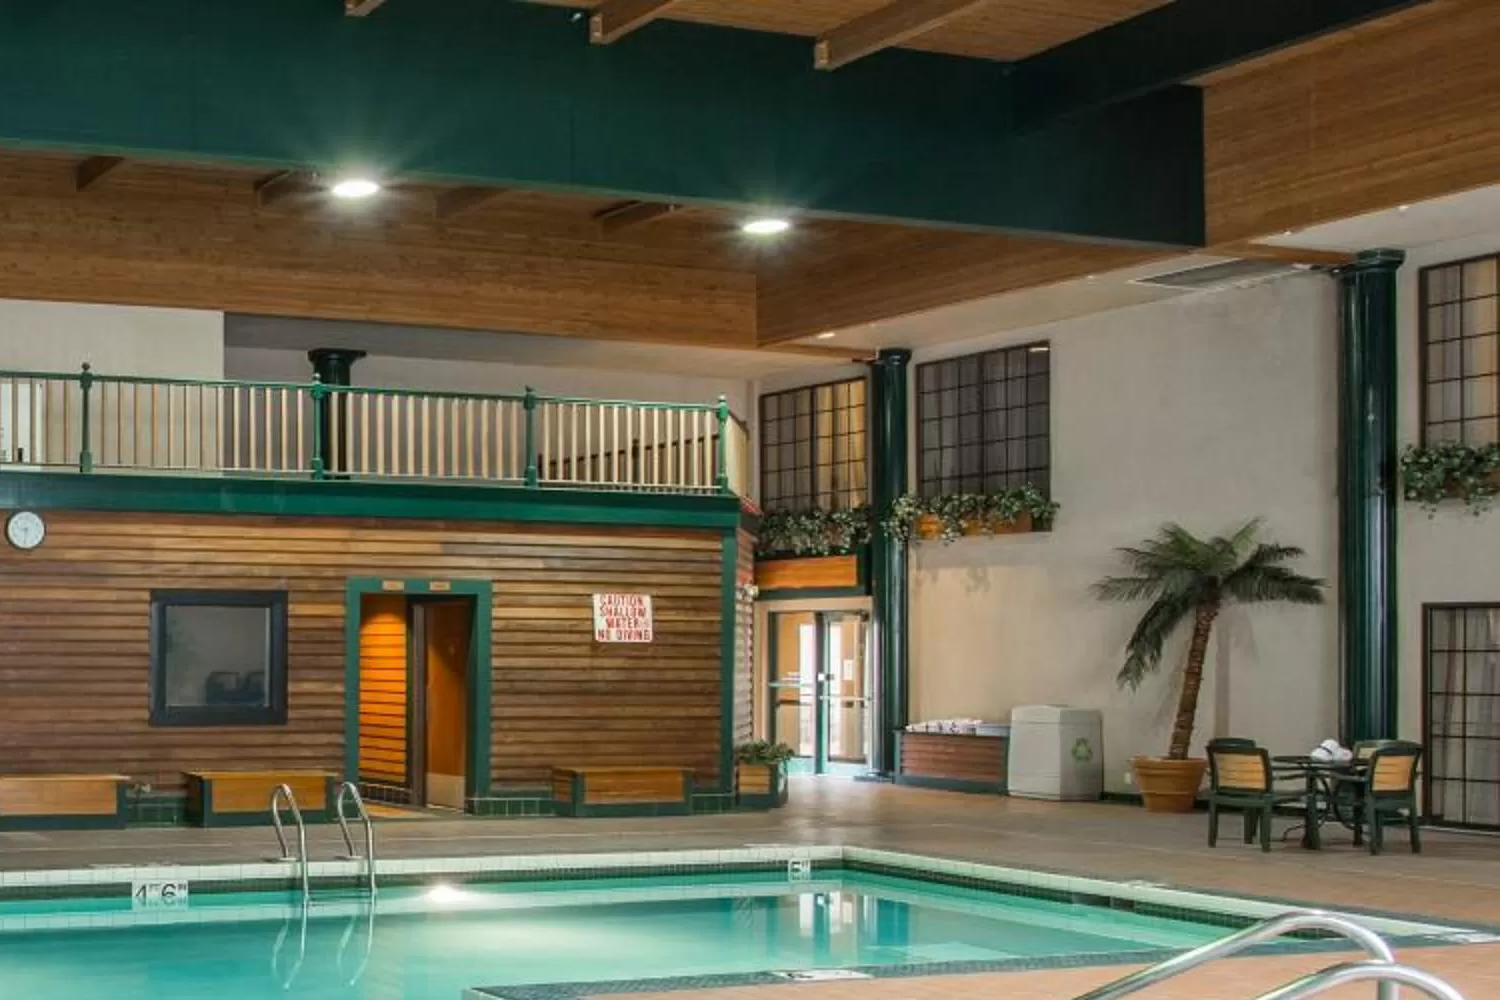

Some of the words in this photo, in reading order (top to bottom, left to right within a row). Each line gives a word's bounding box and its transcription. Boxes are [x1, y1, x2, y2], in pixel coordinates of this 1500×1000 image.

[600, 595, 644, 605] CAUTION
[599, 606, 646, 616] SHALLOW
[606, 617, 640, 628] WATER
[597, 629, 611, 640] NO
[616, 629, 651, 640] DIVING
